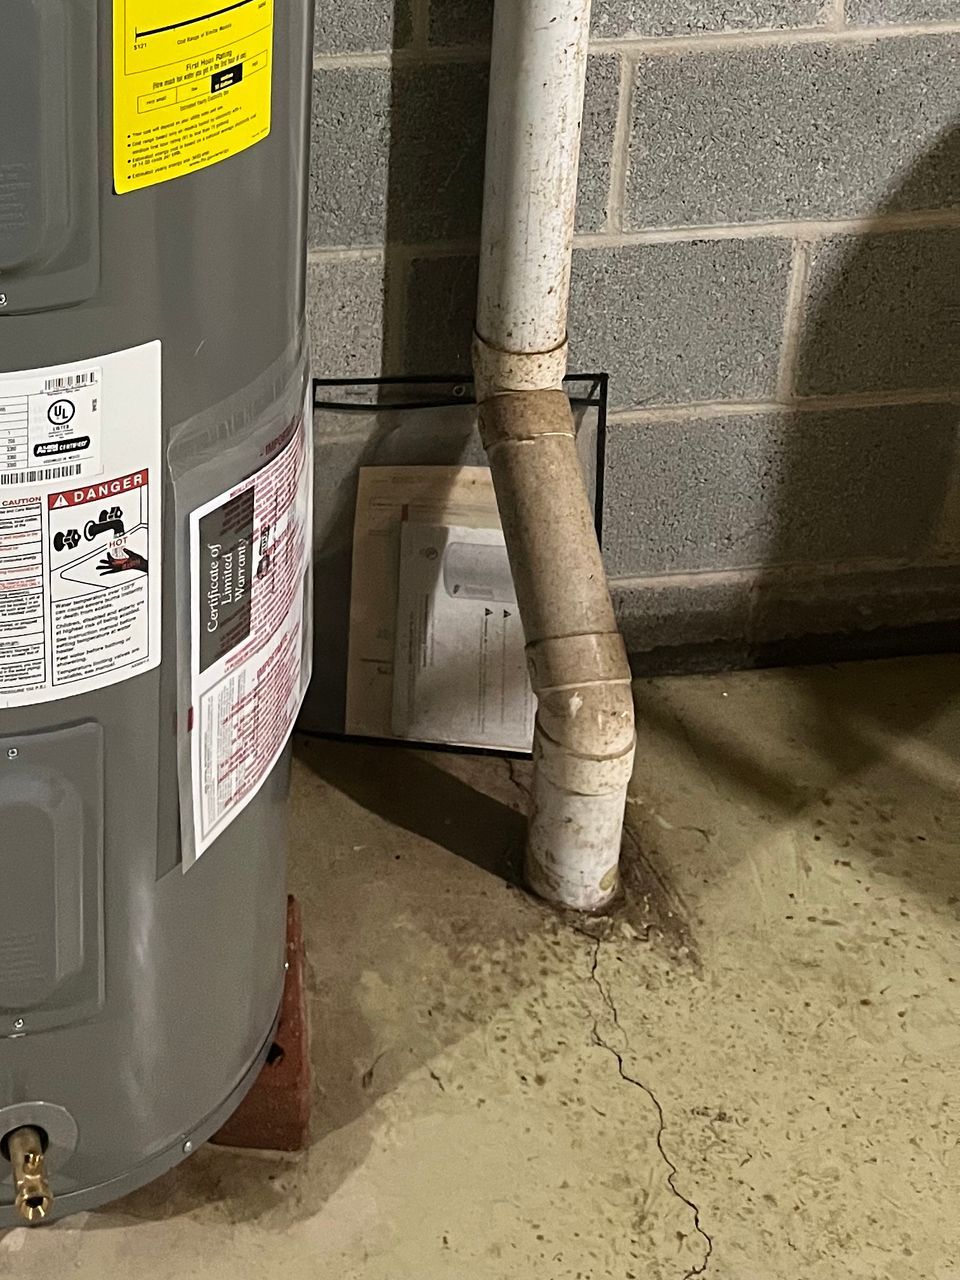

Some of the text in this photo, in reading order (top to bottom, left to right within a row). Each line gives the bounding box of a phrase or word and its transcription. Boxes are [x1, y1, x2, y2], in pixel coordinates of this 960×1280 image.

[186, 62, 199, 71] First
[215, 50, 232, 61] Rating
[54, 404, 68, 419] UL
[73, 474, 144, 502] DANGER
[2, 496, 42, 507] CAUTION
[108, 536, 128, 548] HOT
[233, 537, 249, 602] Warranty
[221, 551, 233, 605] Limited
[121, 586, 143, 597] instantly
[206, 543, 222, 632] Certificate of
[73, 594, 106, 605] temperature
[56, 621, 81, 629] Children,
[83, 613, 105, 623] disabled
[118, 604, 135, 613] elderly
[63, 626, 83, 634] highest
[103, 616, 118, 624] being
[68, 630, 98, 640] instruction
[99, 623, 118, 631] manual
[120, 616, 136, 625] before
[77, 632, 110, 644] temperature
[86, 646, 103, 654] before
[57, 664, 92, 674] Temperature
